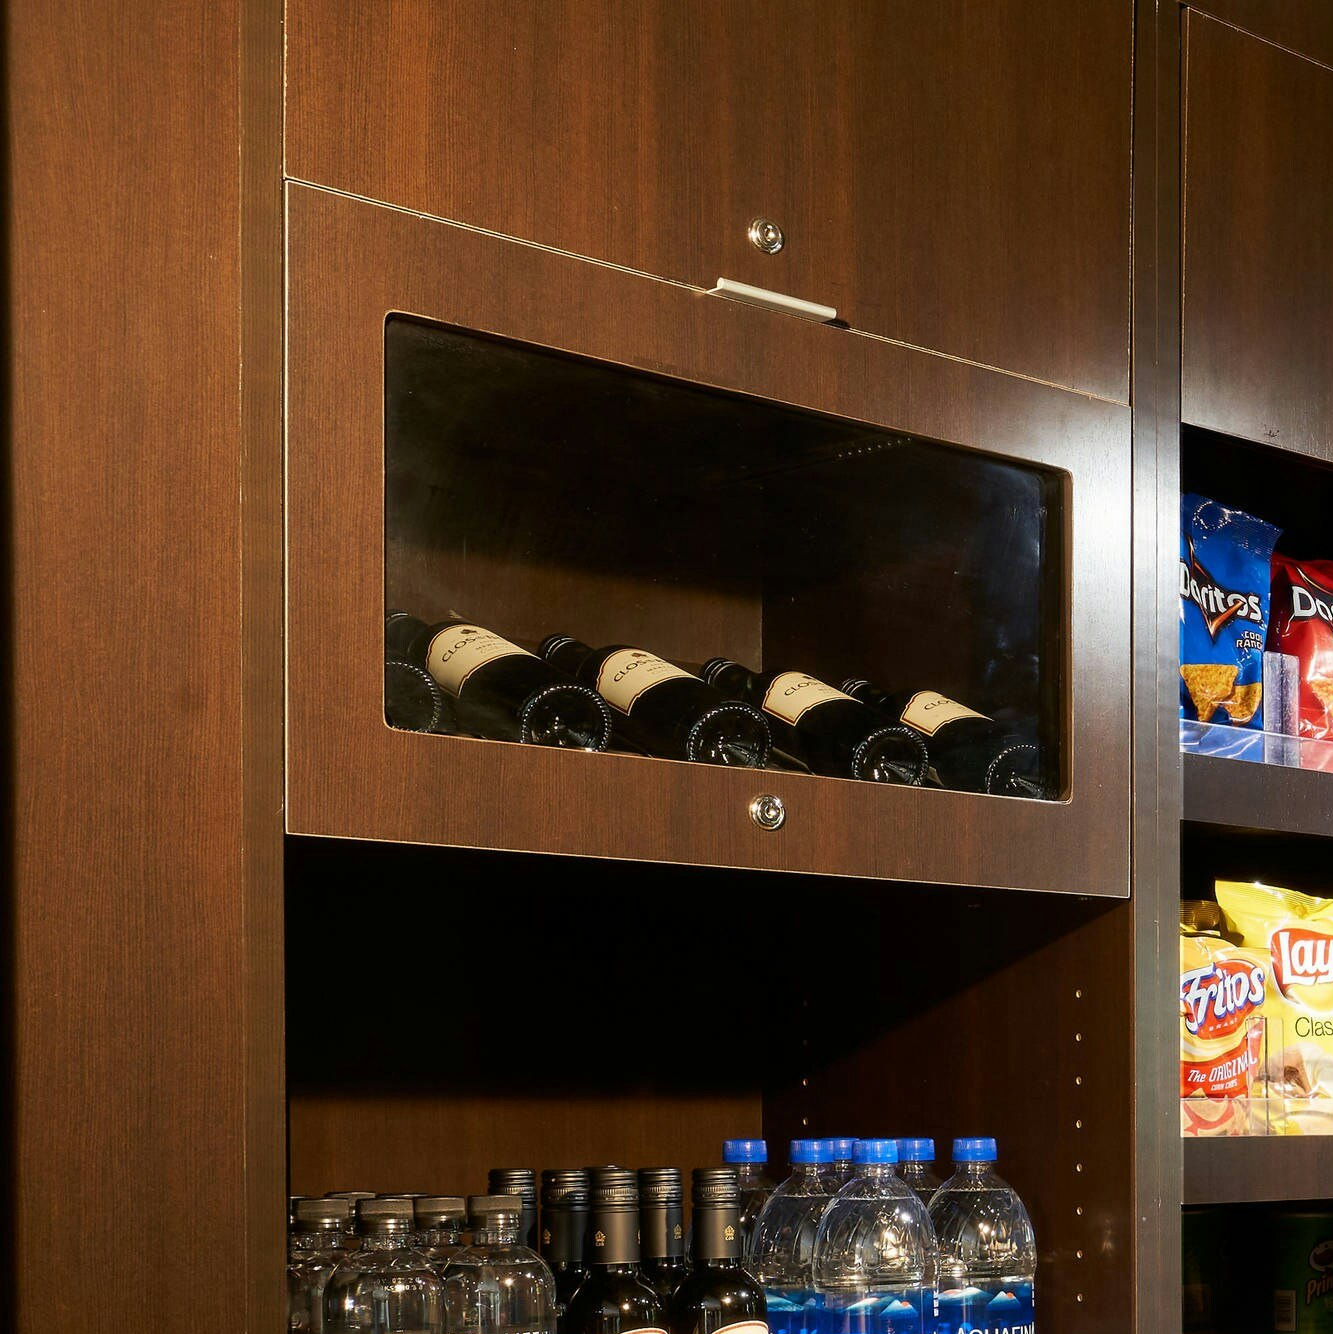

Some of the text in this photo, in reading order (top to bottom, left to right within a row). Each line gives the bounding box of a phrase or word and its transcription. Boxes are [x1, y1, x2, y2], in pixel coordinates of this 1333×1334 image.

[1180, 561, 1263, 622] Doritos
[1180, 961, 1266, 1036] Fritos
[1187, 1069, 1207, 1083] The
